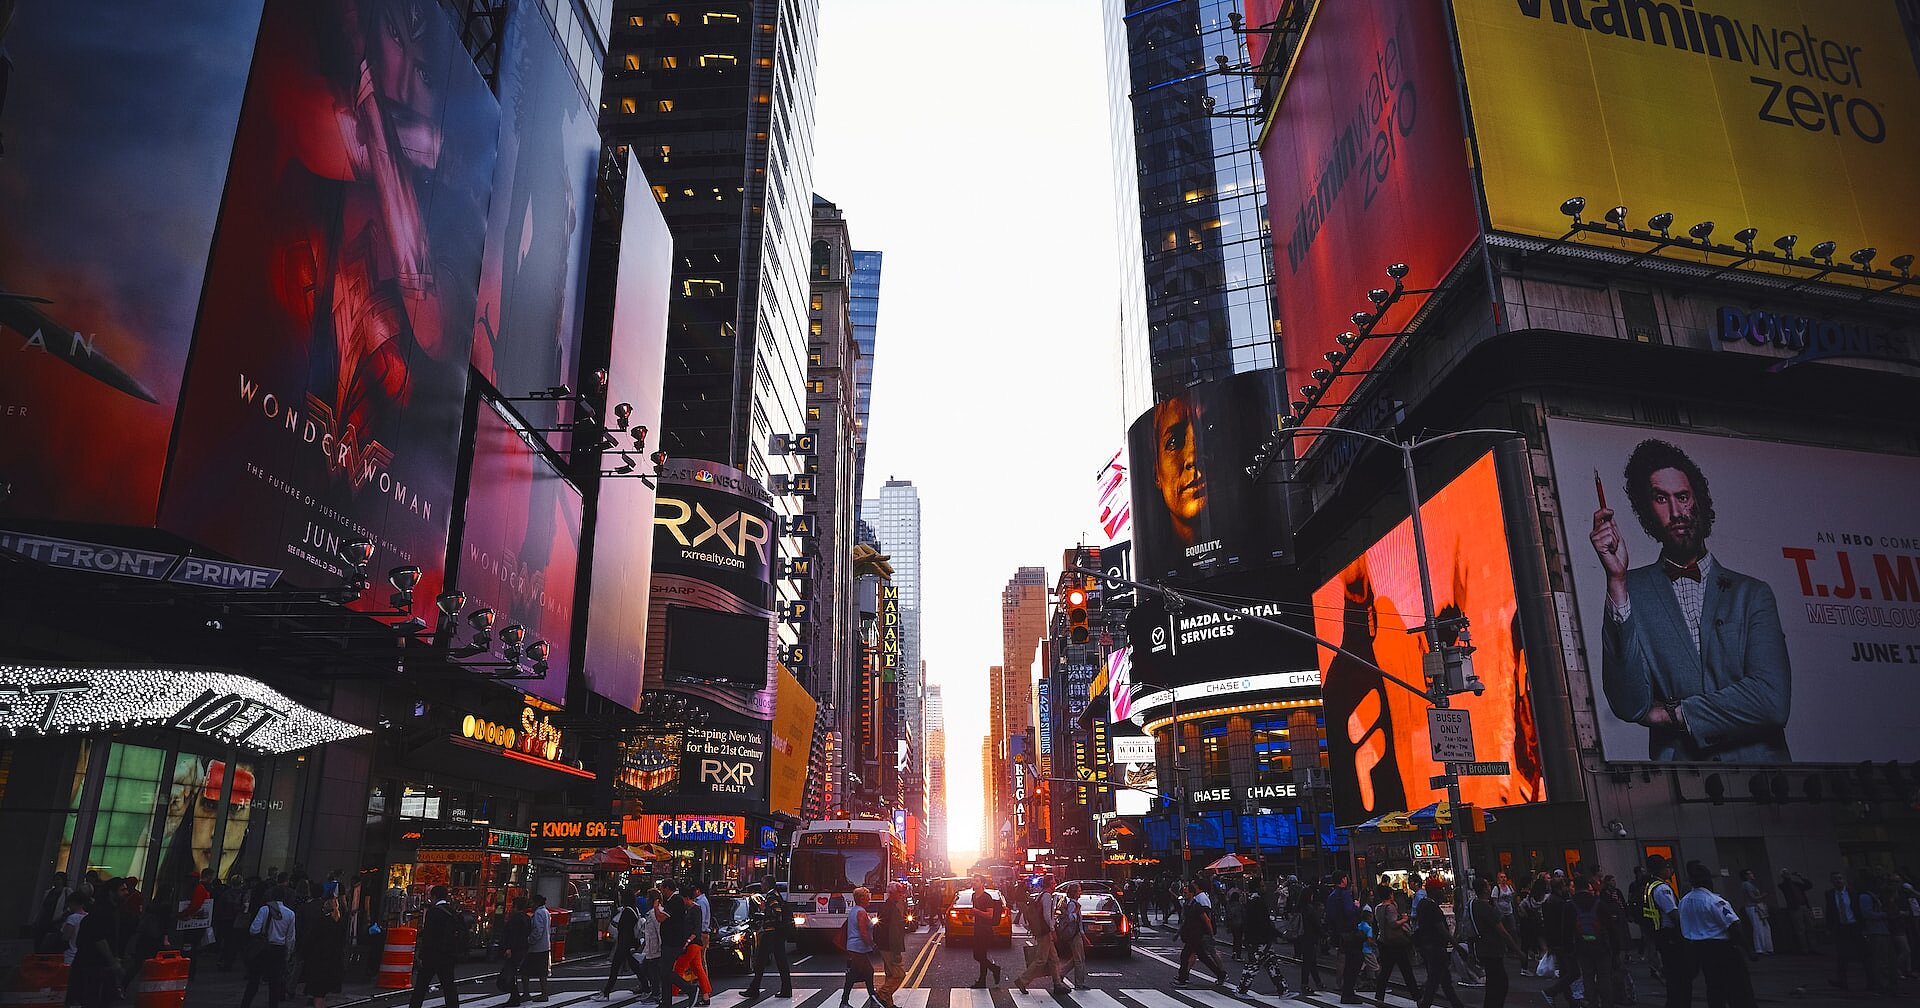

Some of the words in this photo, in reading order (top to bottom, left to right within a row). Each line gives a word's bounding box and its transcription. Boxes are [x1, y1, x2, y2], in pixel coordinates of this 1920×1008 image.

[1749, 75, 1887, 144] zero
[1360, 82, 1416, 211] zero
[1720, 305, 1808, 348] DOW
[0, 324, 96, 360] AN
[239, 373, 353, 468] WONDER
[362, 459, 433, 521] WOMAN
[247, 462, 264, 480] THE
[268, 475, 301, 500] FUTURE
[304, 495, 316, 507] OF
[320, 504, 350, 527] JUSTICE
[352, 522, 379, 543] BEGINS
[381, 539, 398, 554] WITH
[1817, 531, 1835, 544] AN
[1841, 533, 1864, 546] HBO
[681, 549, 746, 570] rxrrealty.com
[184, 561, 270, 589] PRIME
[469, 542, 525, 594] WONDER
[530, 580, 569, 621] WOMAN
[1782, 547, 1873, 600] T.J.
[651, 585, 696, 595] SHARP
[884, 586, 898, 667] MADAME
[1180, 612, 1221, 631] MAZDA
[1180, 624, 1235, 645] SERVICES
[1851, 642, 1904, 664] JUNE
[1206, 682, 1239, 693] CHASE
[1436, 713, 1462, 723] BUSES
[729, 730, 747, 742] New
[747, 732, 762, 745] York
[1440, 724, 1460, 734] ONLY
[686, 740, 702, 752] for
[704, 742, 720, 754] the
[720, 744, 737, 756] 21st
[738, 745, 764, 762] Century
[1095, 720, 1107, 765] VICTORY
[700, 759, 754, 786] RXR
[1470, 764, 1508, 774] Broadway
[711, 783, 747, 794] REALTY
[1014, 763, 1026, 827] REGAL
[1247, 784, 1297, 799] CHASE
[542, 821, 583, 838] KNOW
[658, 819, 736, 839] CHAMPS
[1414, 843, 1440, 857] SODA
